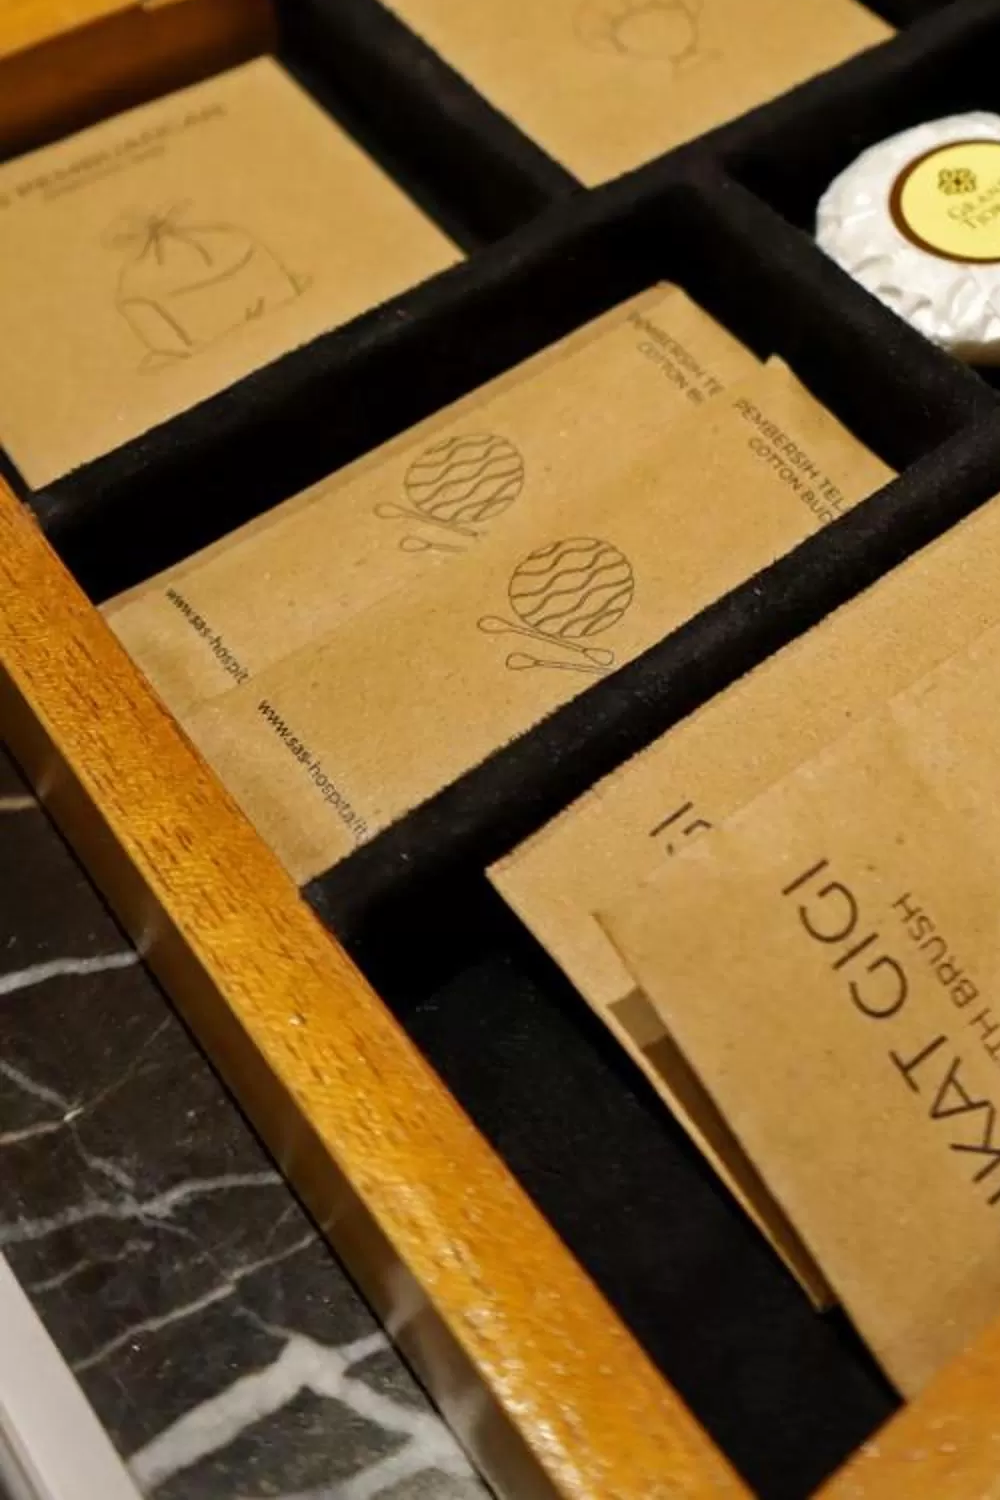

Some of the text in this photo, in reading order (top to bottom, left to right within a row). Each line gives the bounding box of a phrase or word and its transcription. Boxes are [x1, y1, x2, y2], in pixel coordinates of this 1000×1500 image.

[732, 399, 821, 481] PEMBERSIH
[747, 436, 803, 491] COTTON
[781, 858, 909, 1020] GIGI
[891, 892, 980, 1010] BRUSH
